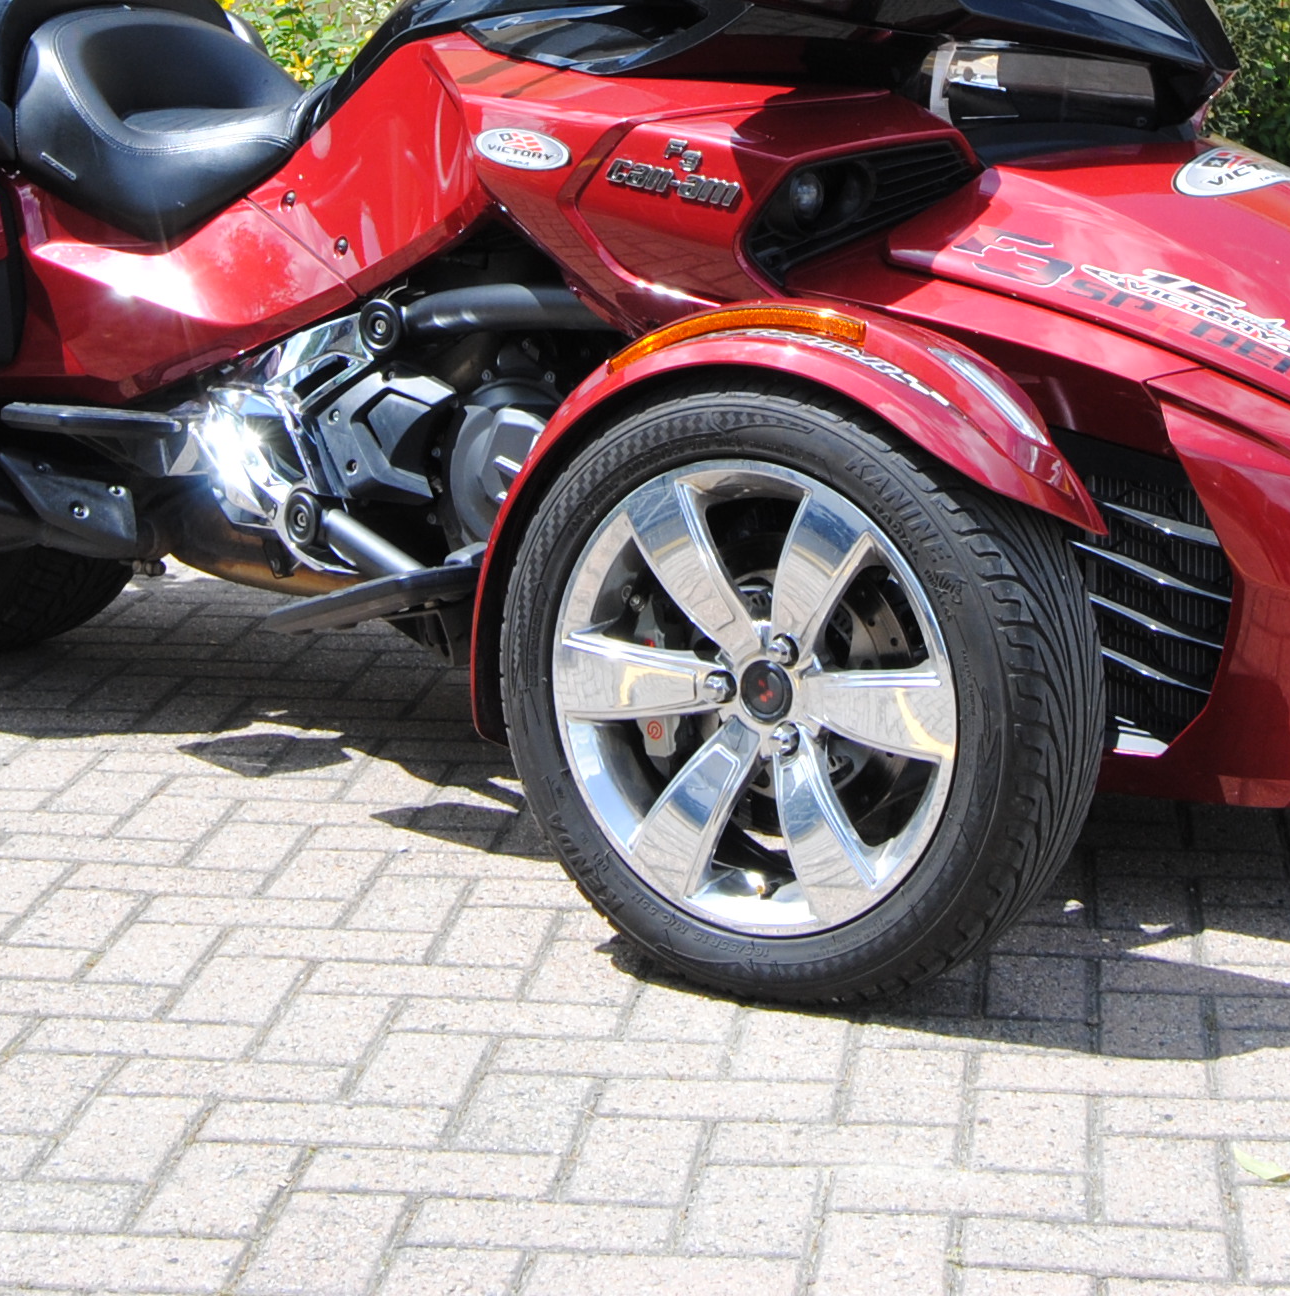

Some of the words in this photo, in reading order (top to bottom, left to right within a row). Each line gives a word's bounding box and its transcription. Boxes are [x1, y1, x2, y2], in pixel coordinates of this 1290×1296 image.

[487, 143, 554, 161] VICTORY
[664, 138, 703, 172] F3
[1128, 280, 1279, 339] VICTORY
[845, 455, 952, 562] KANINE
[547, 811, 624, 915] KENDA
[692, 931, 770, 958] 165/55R15
